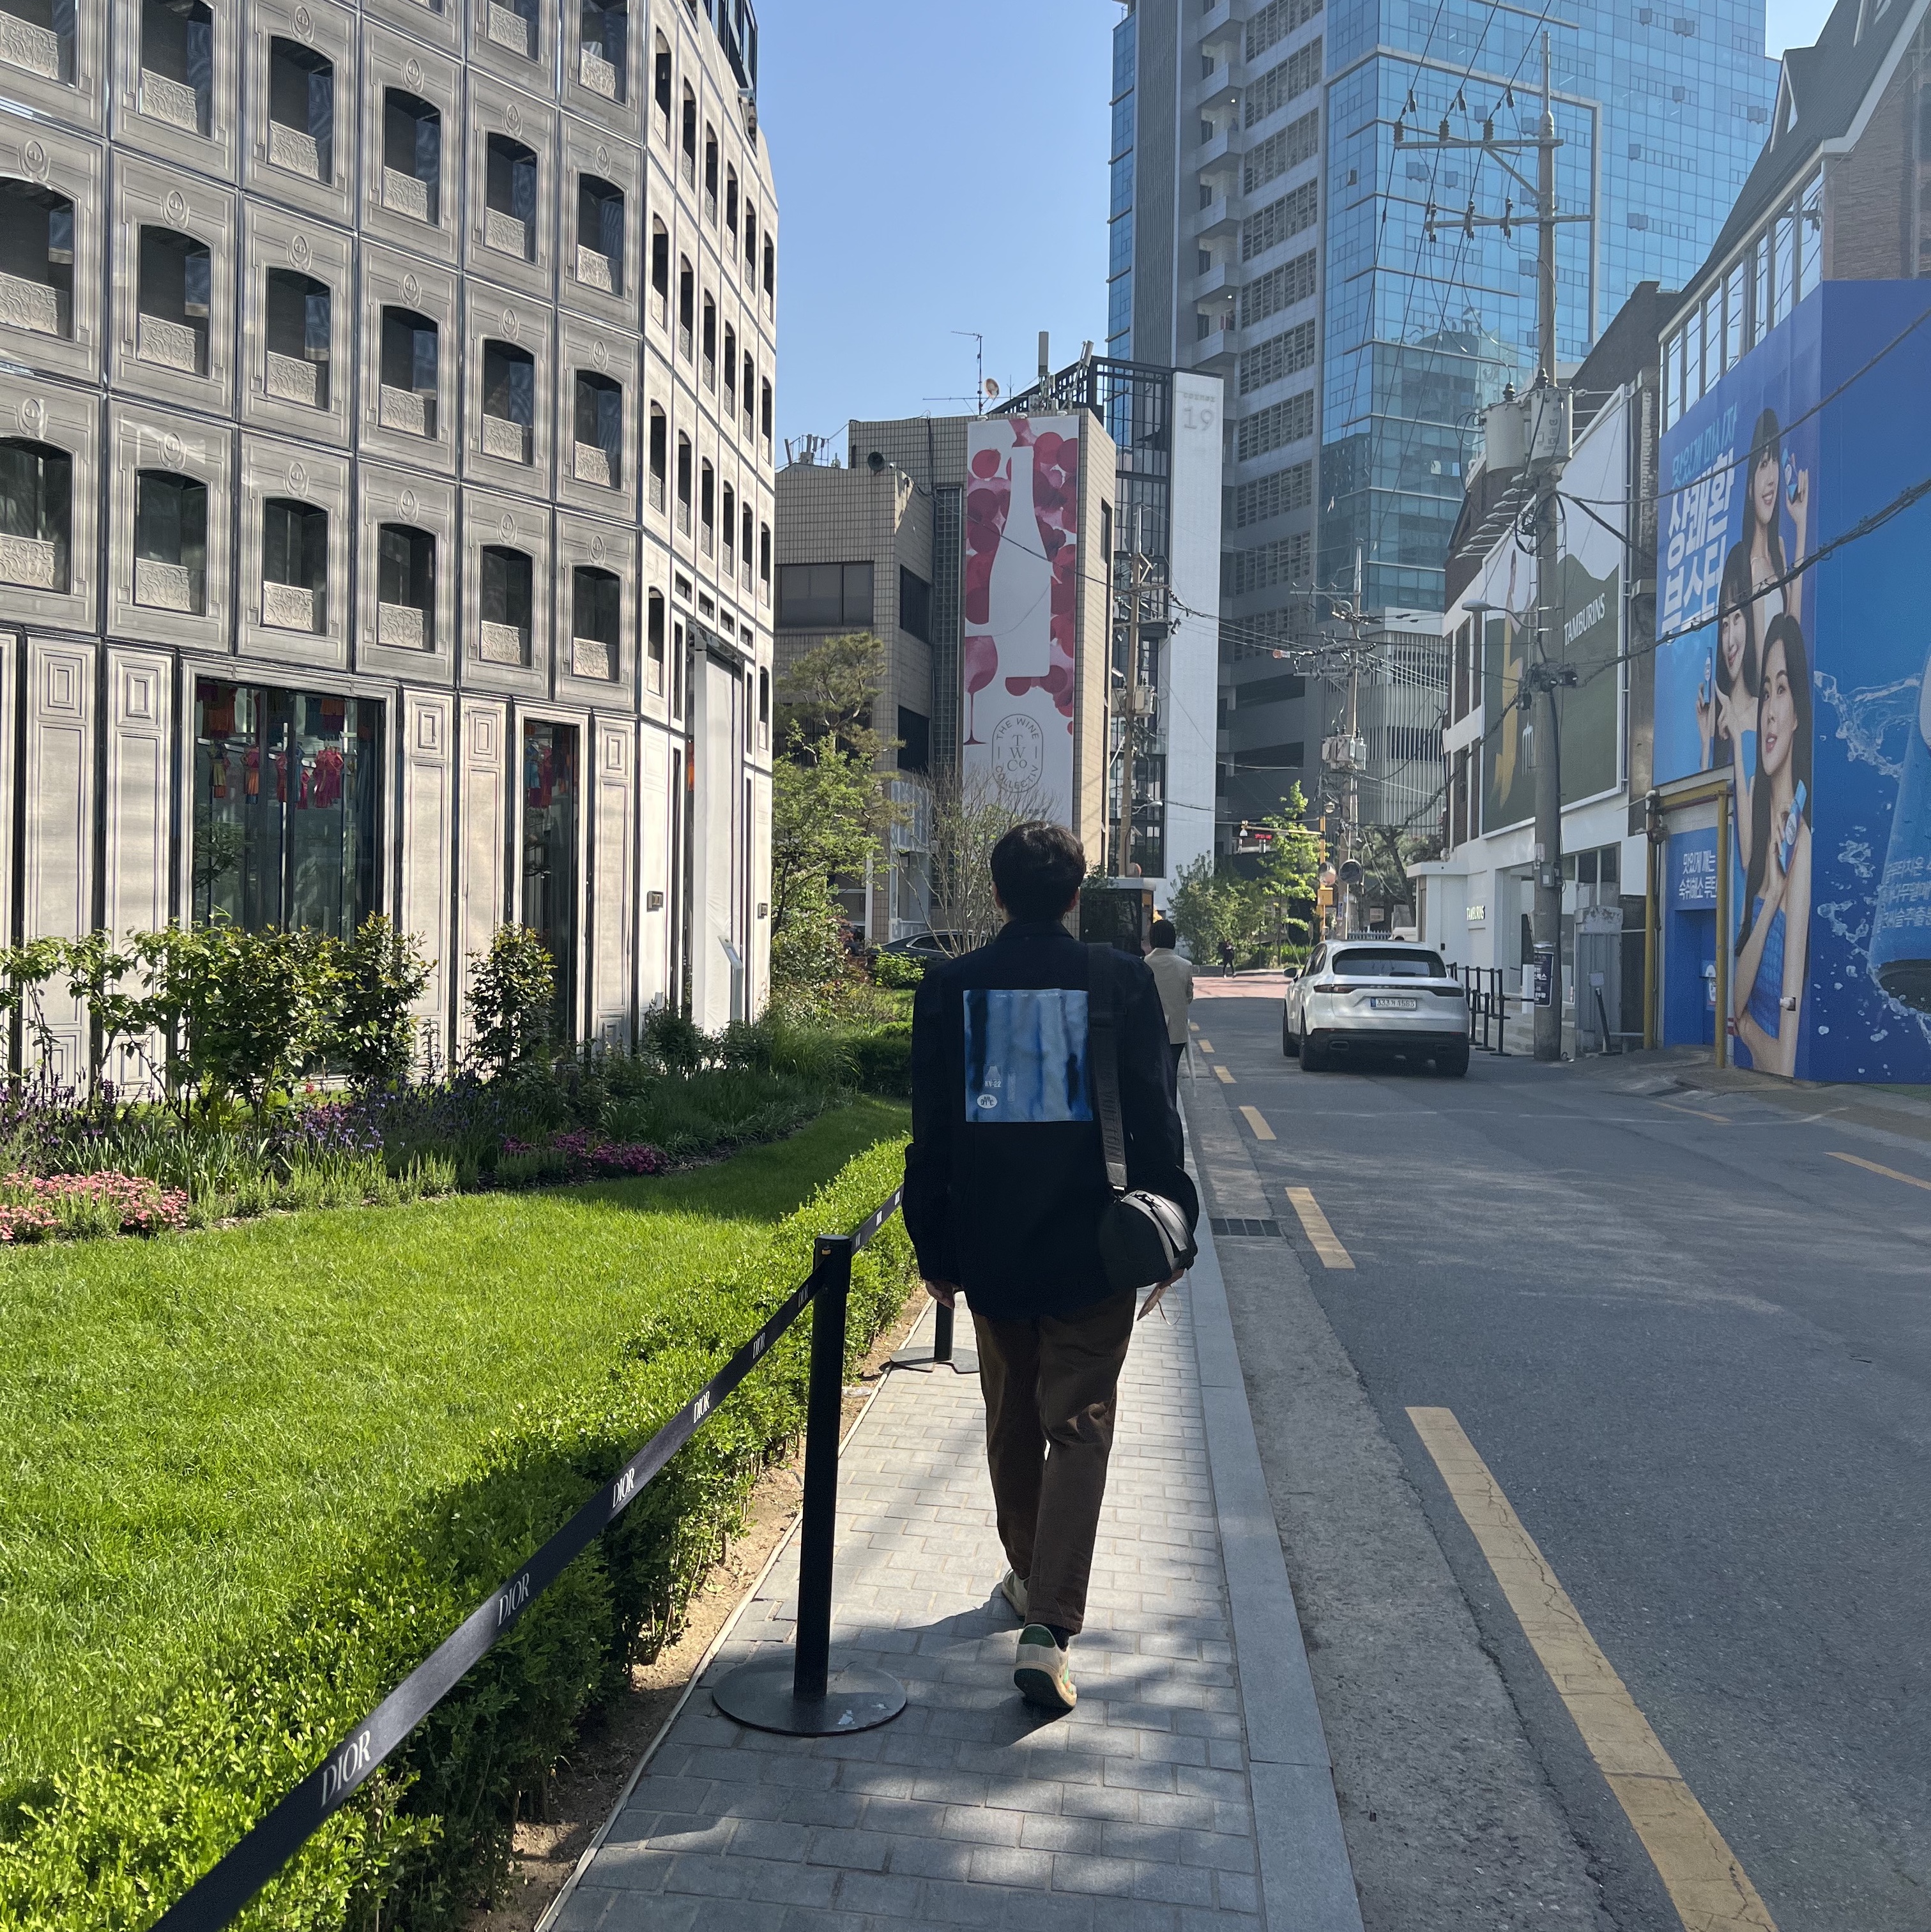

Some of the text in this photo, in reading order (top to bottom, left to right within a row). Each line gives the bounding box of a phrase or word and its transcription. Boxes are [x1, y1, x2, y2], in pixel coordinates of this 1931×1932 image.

[1184, 406, 1214, 432] 19
[1672, 432, 1704, 490] 맛있게
[1667, 447, 1735, 570] 상쾌환
[1661, 535, 1727, 646] 부스터
[1564, 593, 1605, 646] TAMBURINS
[996, 718, 1039, 740] THE WINE
[752, 1332, 766, 1360] DIOR
[694, 1390, 710, 1424] DIOR
[613, 1467, 635, 1509] DIOR
[498, 1572, 530, 1627] DIOR
[321, 1730, 370, 1808] DIOR
